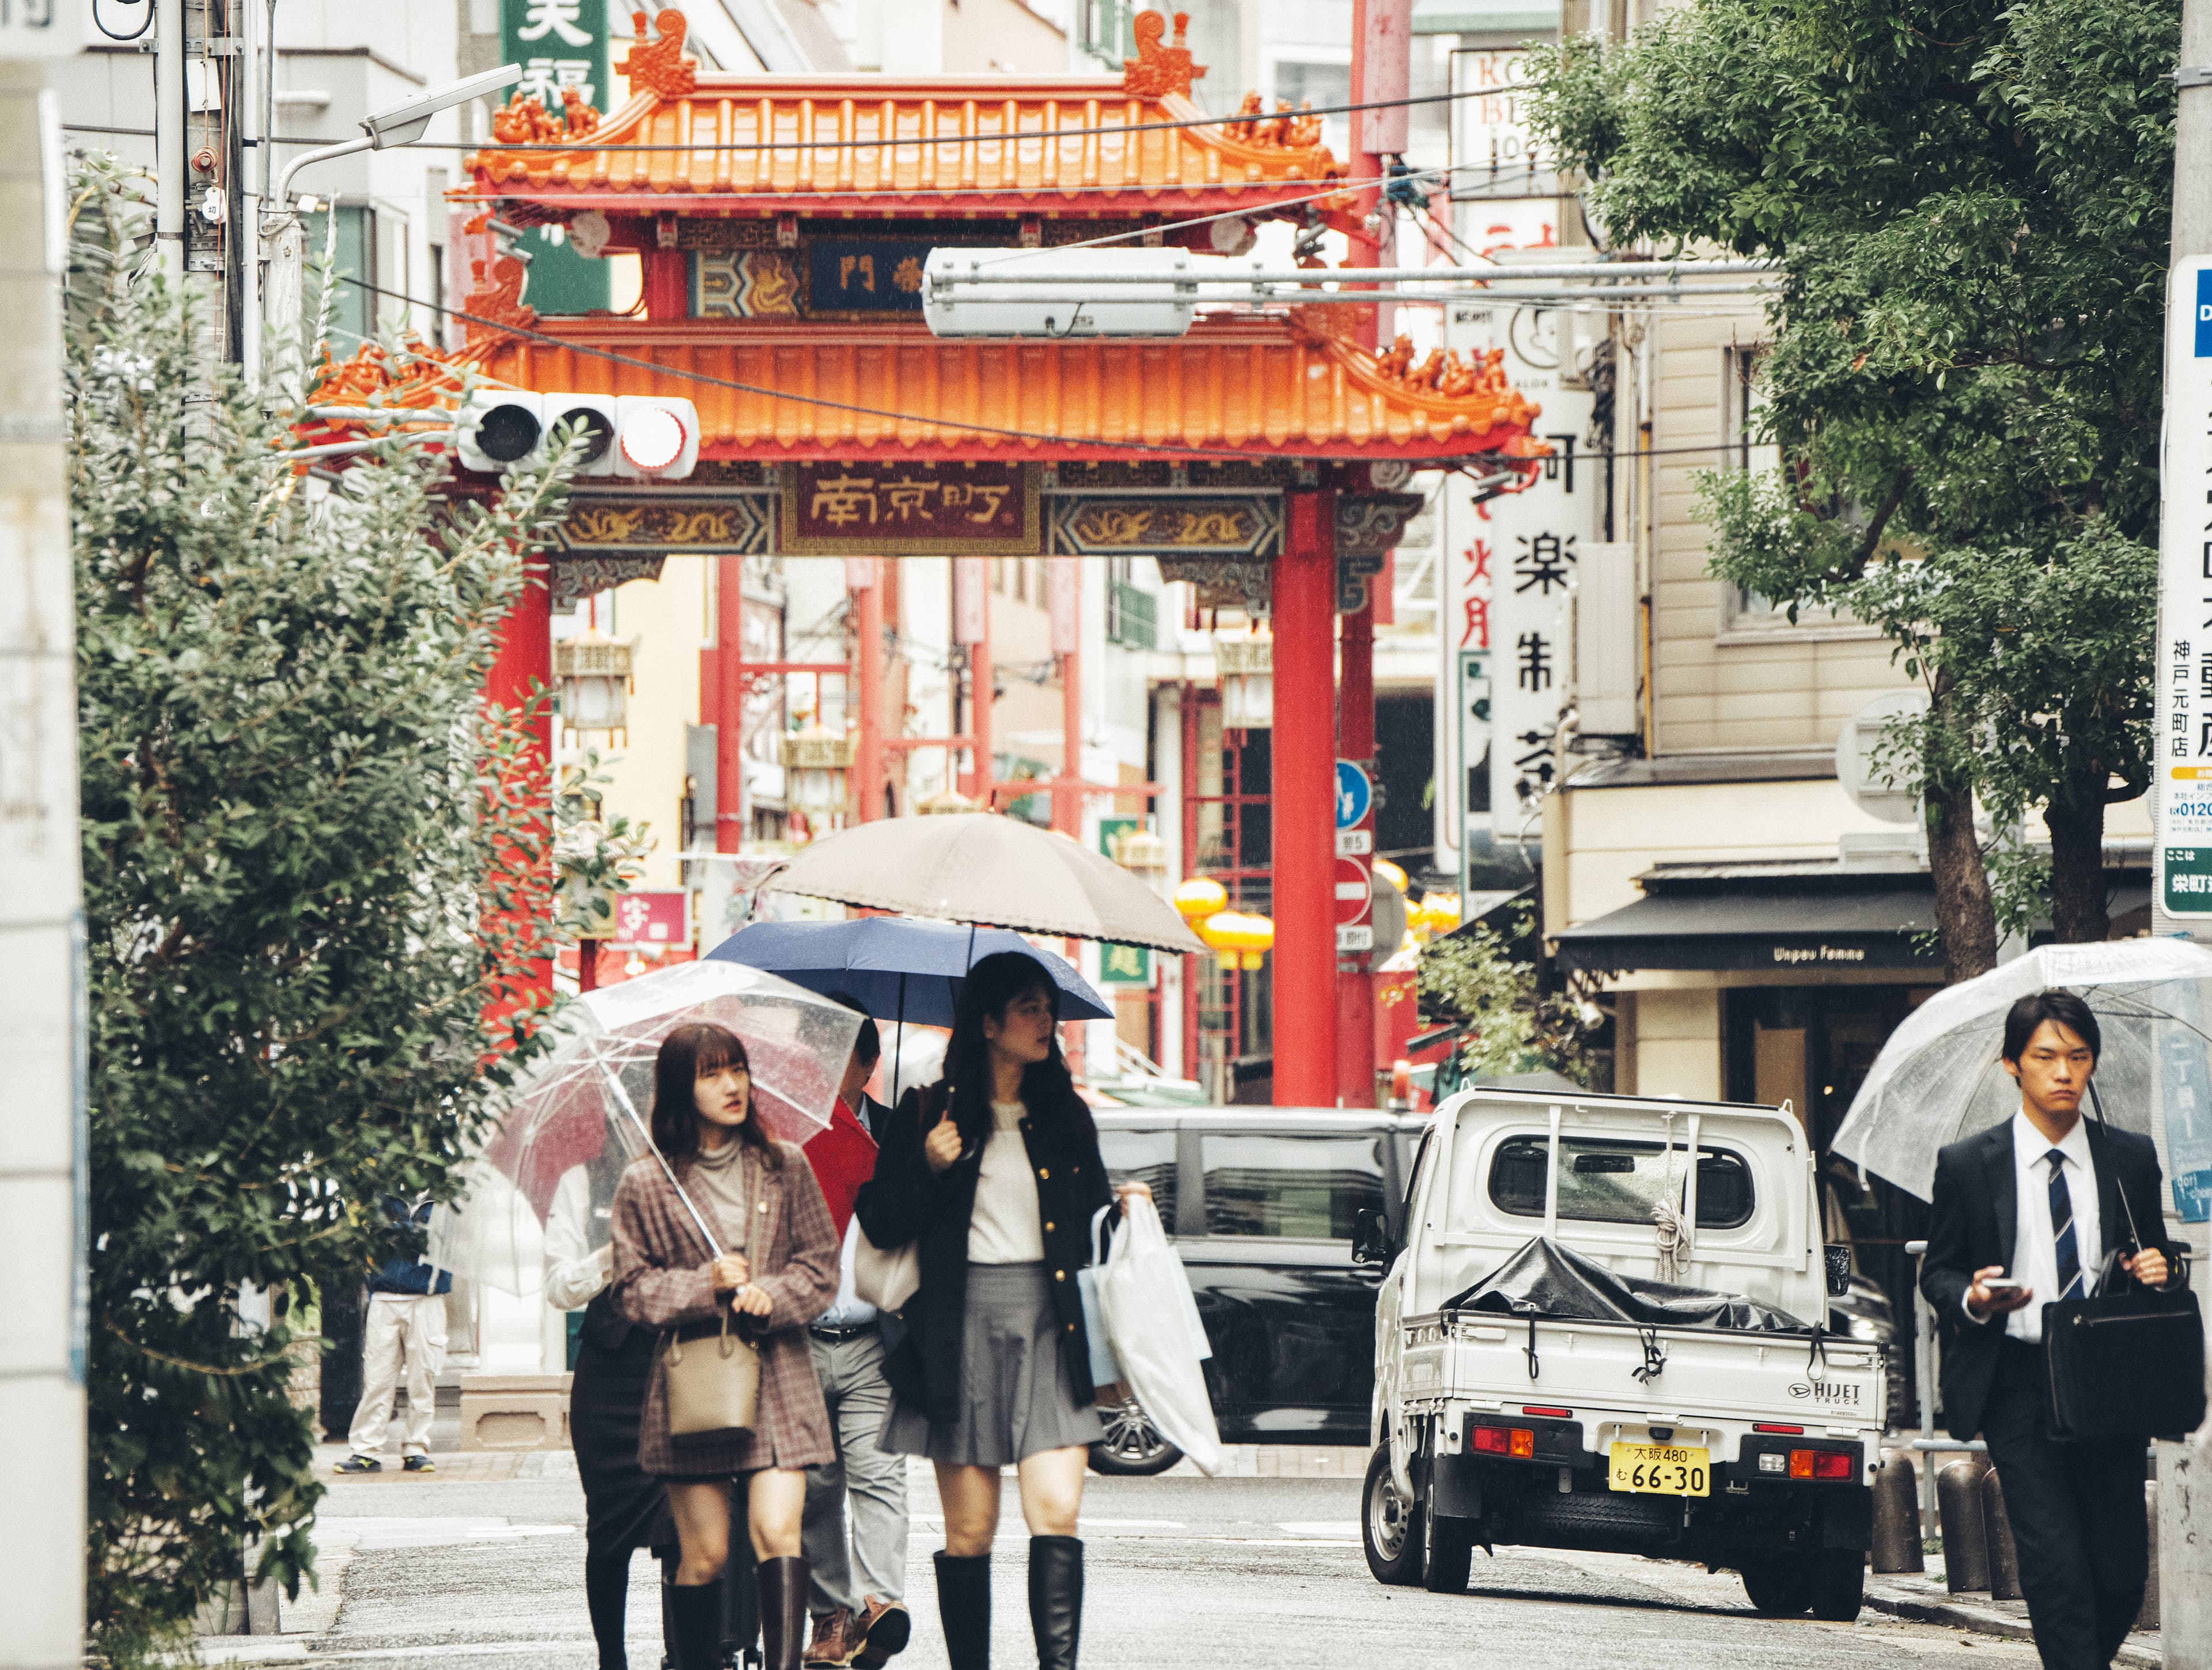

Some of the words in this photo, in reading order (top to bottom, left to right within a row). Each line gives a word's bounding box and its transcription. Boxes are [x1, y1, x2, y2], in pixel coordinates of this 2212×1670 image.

[810, 473, 1011, 528] 南京町
[2171, 639, 2190, 758] 神戸元町店
[2166, 850, 2195, 861] ここは
[2172, 873, 2212, 893] 栄町
[1815, 1383, 1860, 1399] HIJET
[1815, 1398, 1859, 1406] TRUCK
[1616, 1468, 1627, 1480] む
[1632, 1464, 1703, 1491] 66-30
